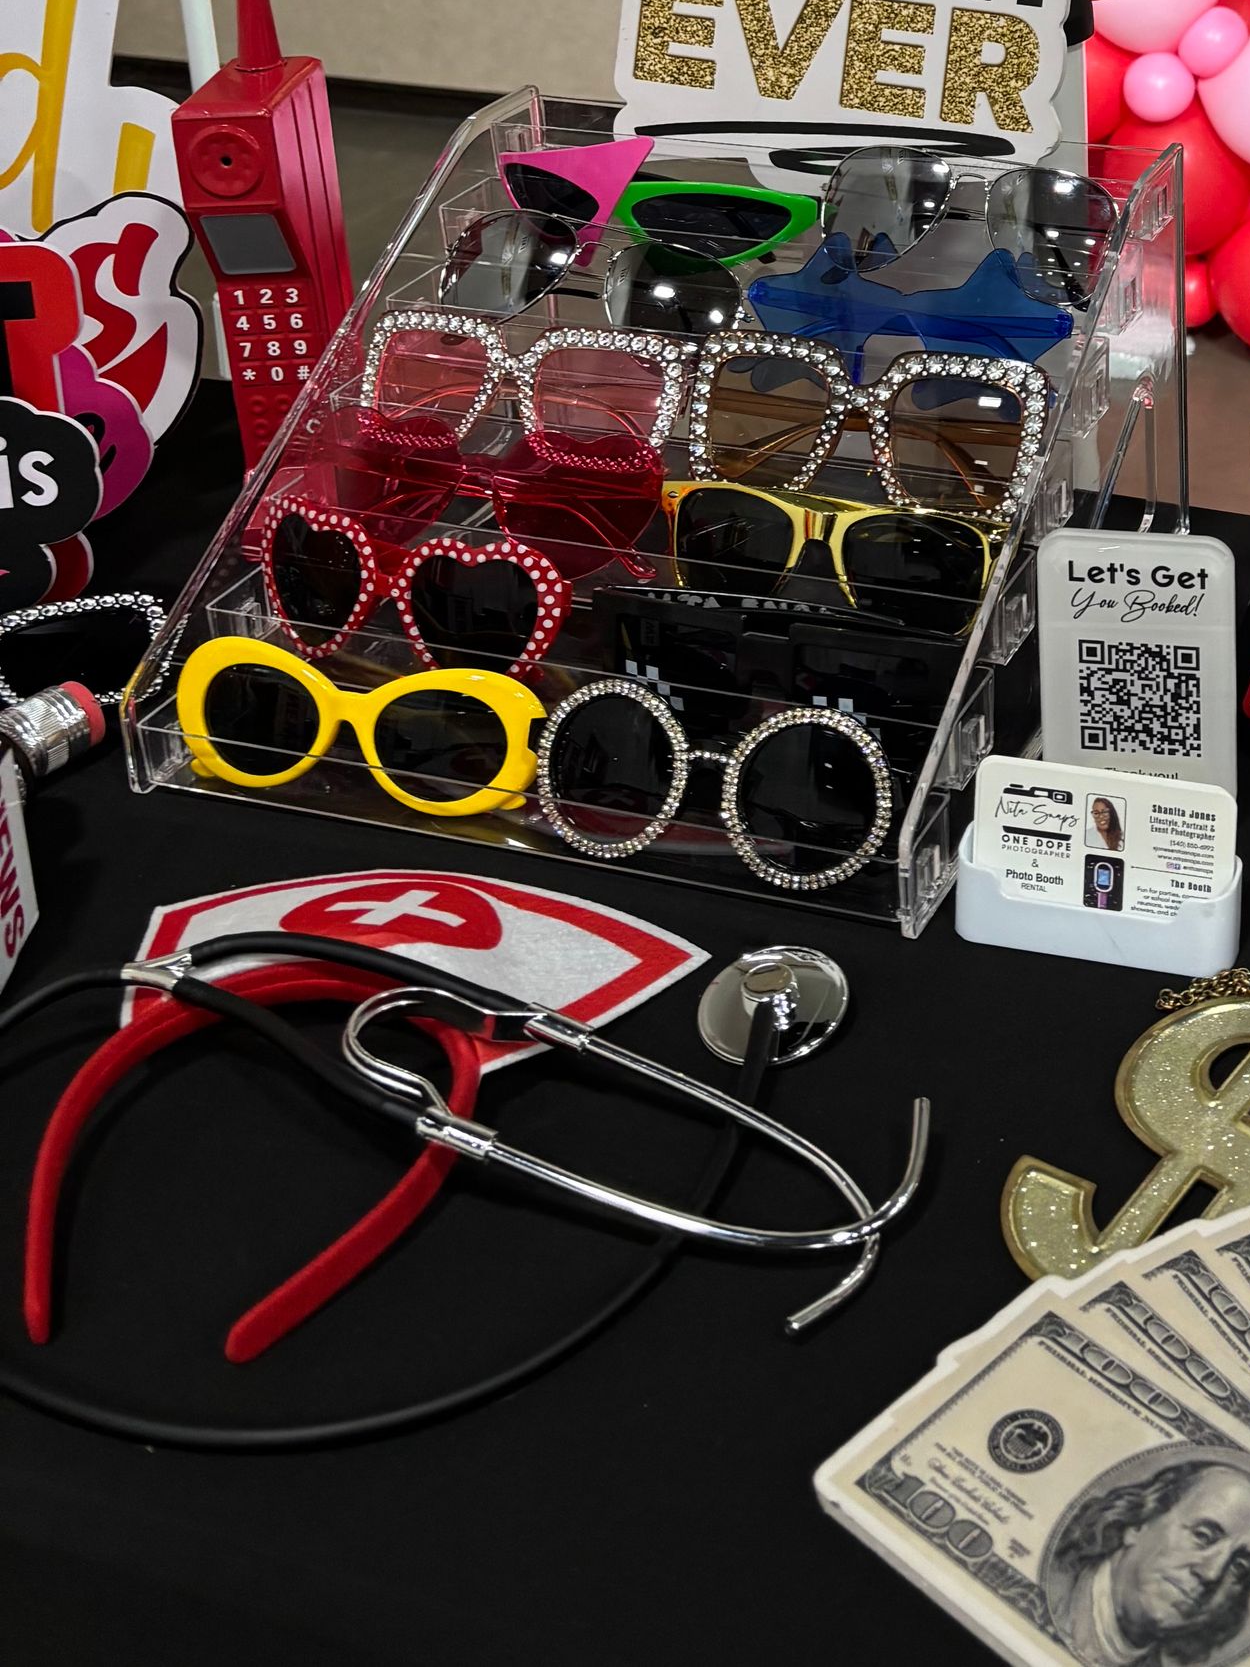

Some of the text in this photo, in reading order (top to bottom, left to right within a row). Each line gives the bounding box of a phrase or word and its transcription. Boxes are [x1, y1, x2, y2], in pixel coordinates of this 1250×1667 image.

[234, 288, 298, 305] 1 2 3
[236, 313, 303, 330] 4 5 6
[239, 340, 307, 357] 7 8 9
[1068, 560, 1208, 590] Let's Get
[1071, 587, 1119, 619] You
[995, 796, 1080, 831] Nita Snaps
[1152, 804, 1216, 821] Shanita Jones
[1150, 825, 1215, 840] Event Photographer
[1182, 821, 1208, 832] Portrait
[1002, 834, 1072, 851] ONE DOPE
[1001, 844, 1071, 859] PHOTOGRAPHER
[1005, 869, 1064, 885] Photo Booth
[1021, 883, 1047, 892] RENTAL
[1170, 879, 1212, 893] The Booth
[875, 1472, 994, 1560] 100
